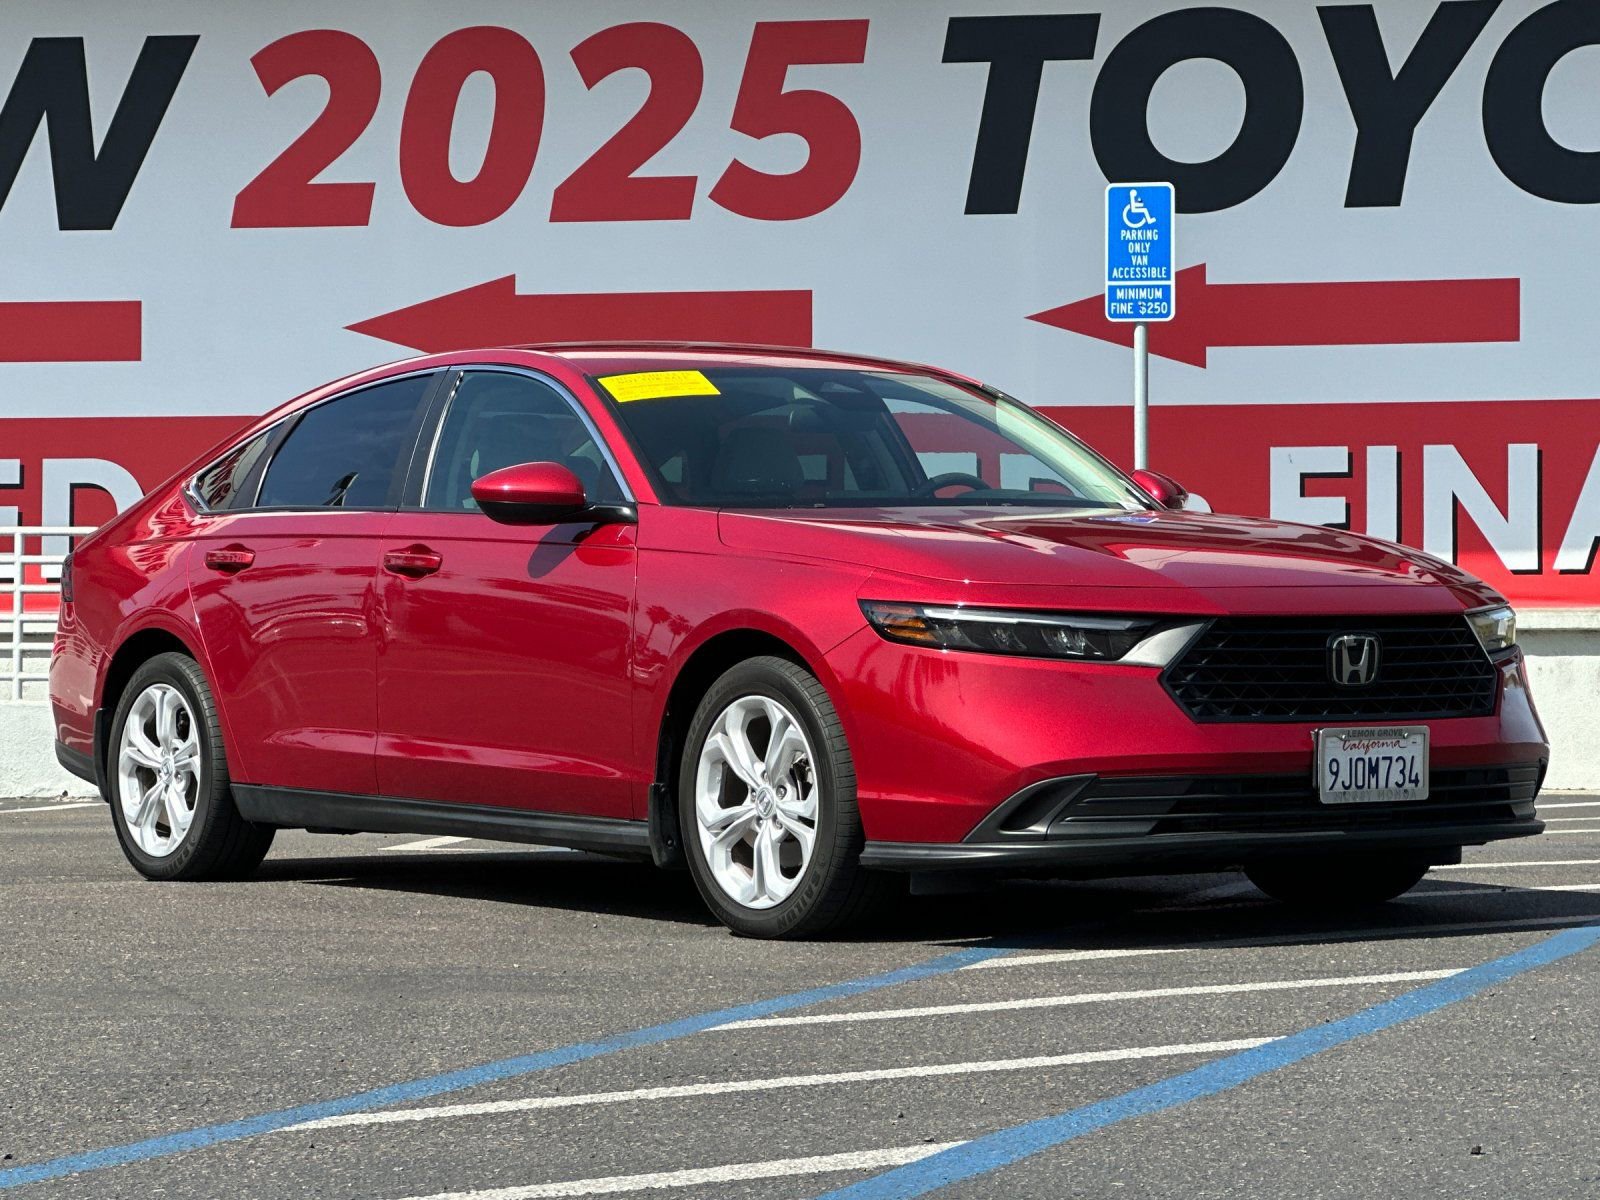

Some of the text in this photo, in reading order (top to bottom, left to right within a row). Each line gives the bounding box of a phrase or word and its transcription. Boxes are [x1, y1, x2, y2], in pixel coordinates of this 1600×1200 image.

[230, 19, 869, 229] 2025
[942, 0, 1600, 215] TOYO
[1120, 229, 1159, 241] PARKING
[1128, 242, 1151, 254] ONLY
[1131, 255, 1149, 266] VAN
[1112, 267, 1167, 279] ACCESSIBLE
[1116, 287, 1163, 300] MINIMUM
[1110, 301, 1168, 316] FINE $250
[1347, 728, 1404, 738] LEMON GROVE
[1342, 739, 1407, 755] California
